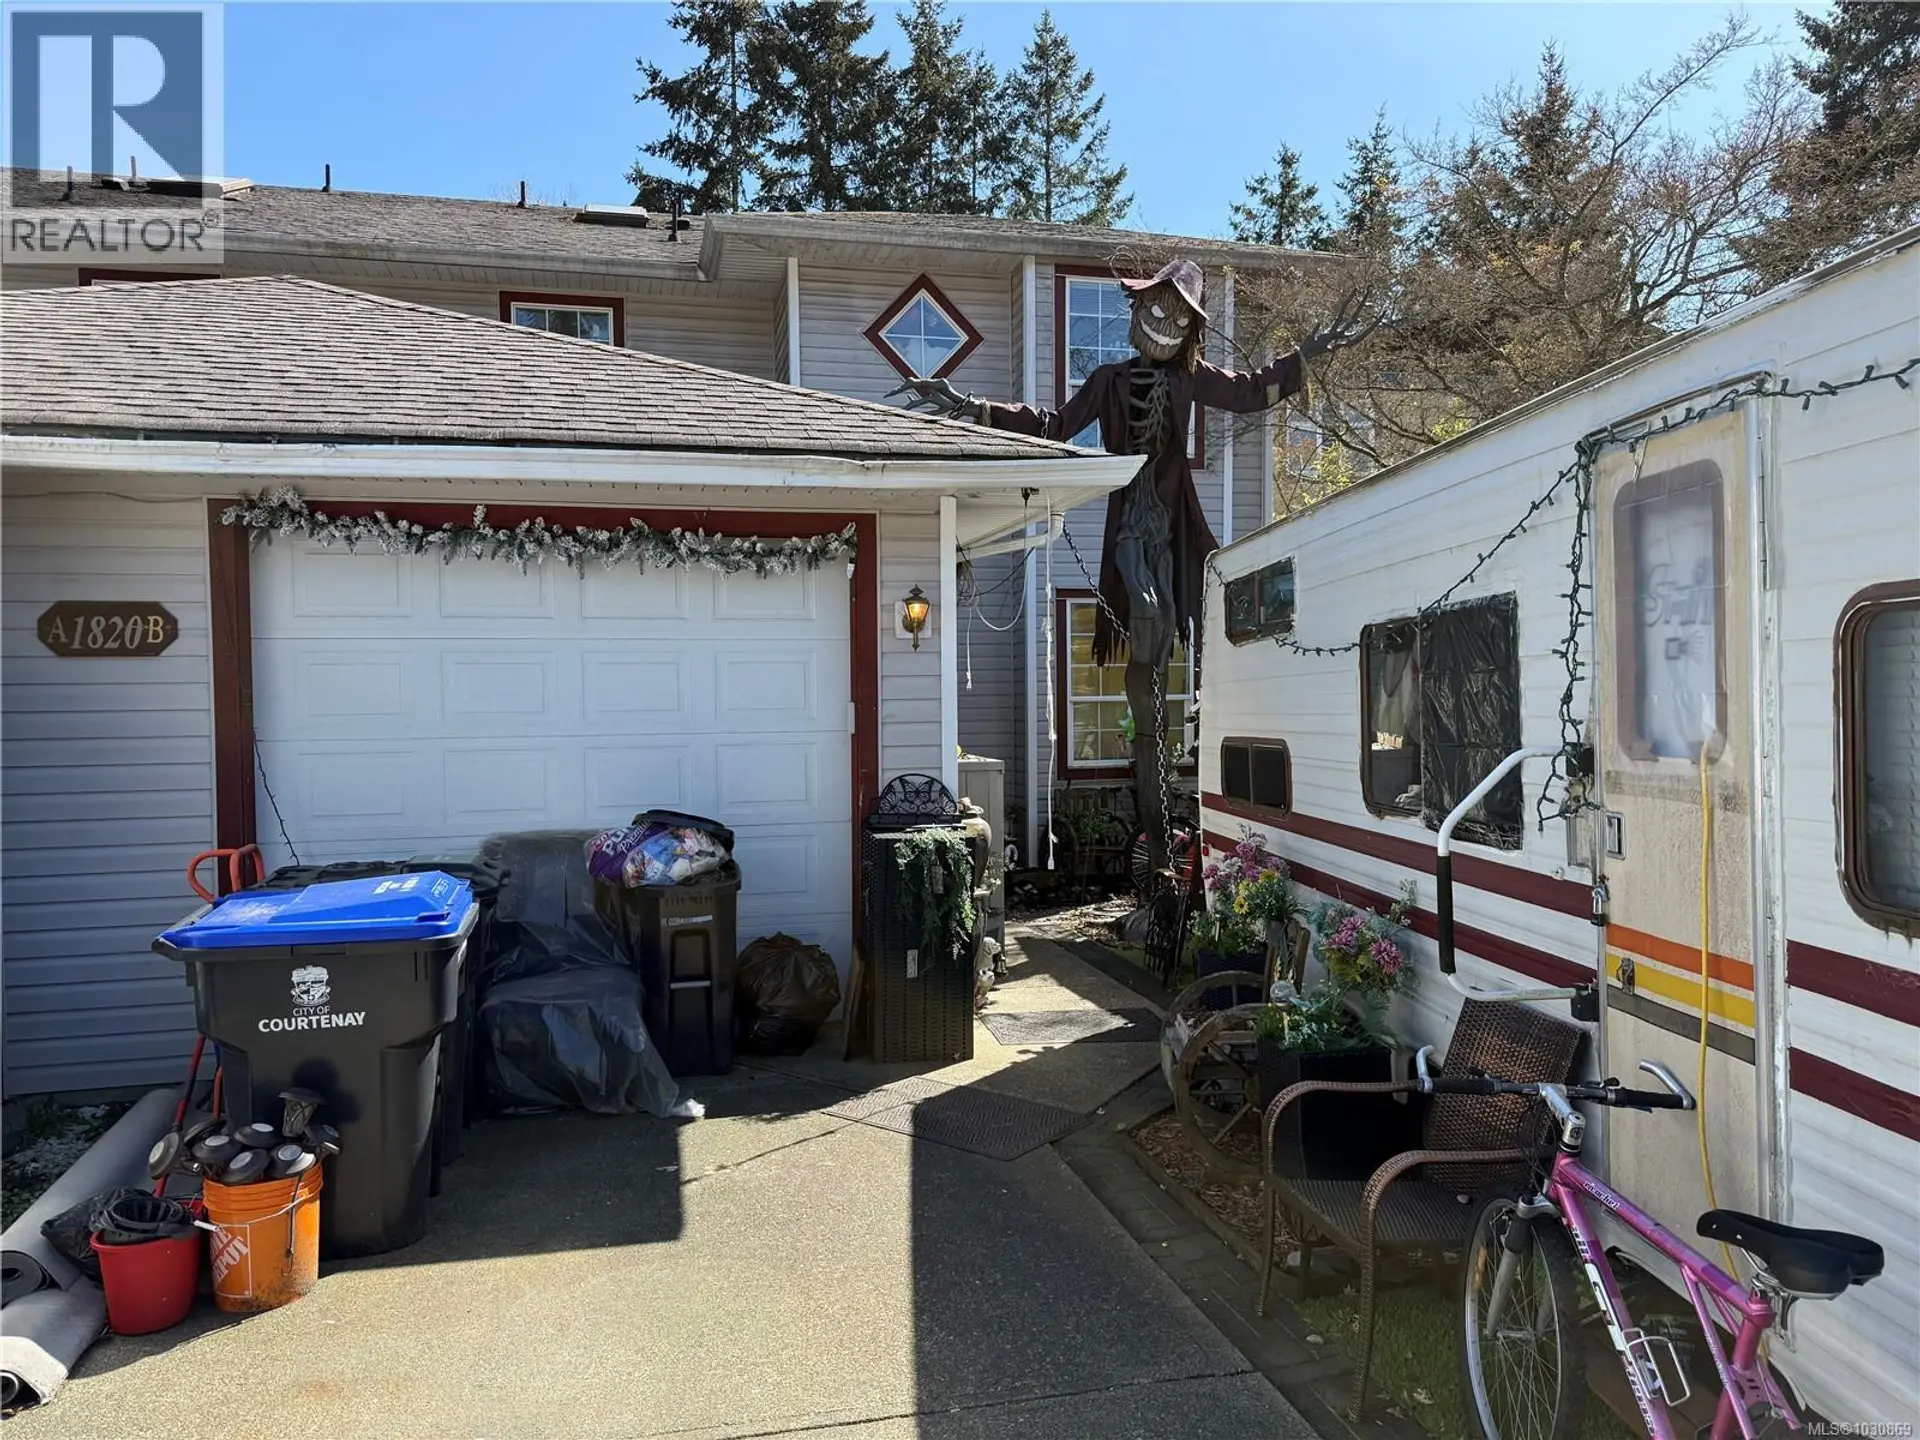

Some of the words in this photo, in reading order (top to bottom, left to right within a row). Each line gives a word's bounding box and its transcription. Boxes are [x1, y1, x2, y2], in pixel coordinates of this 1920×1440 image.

[293, 1006, 315, 1017] CITY
[316, 1005, 331, 1015] OF
[258, 1011, 366, 1033] COURTENAY
